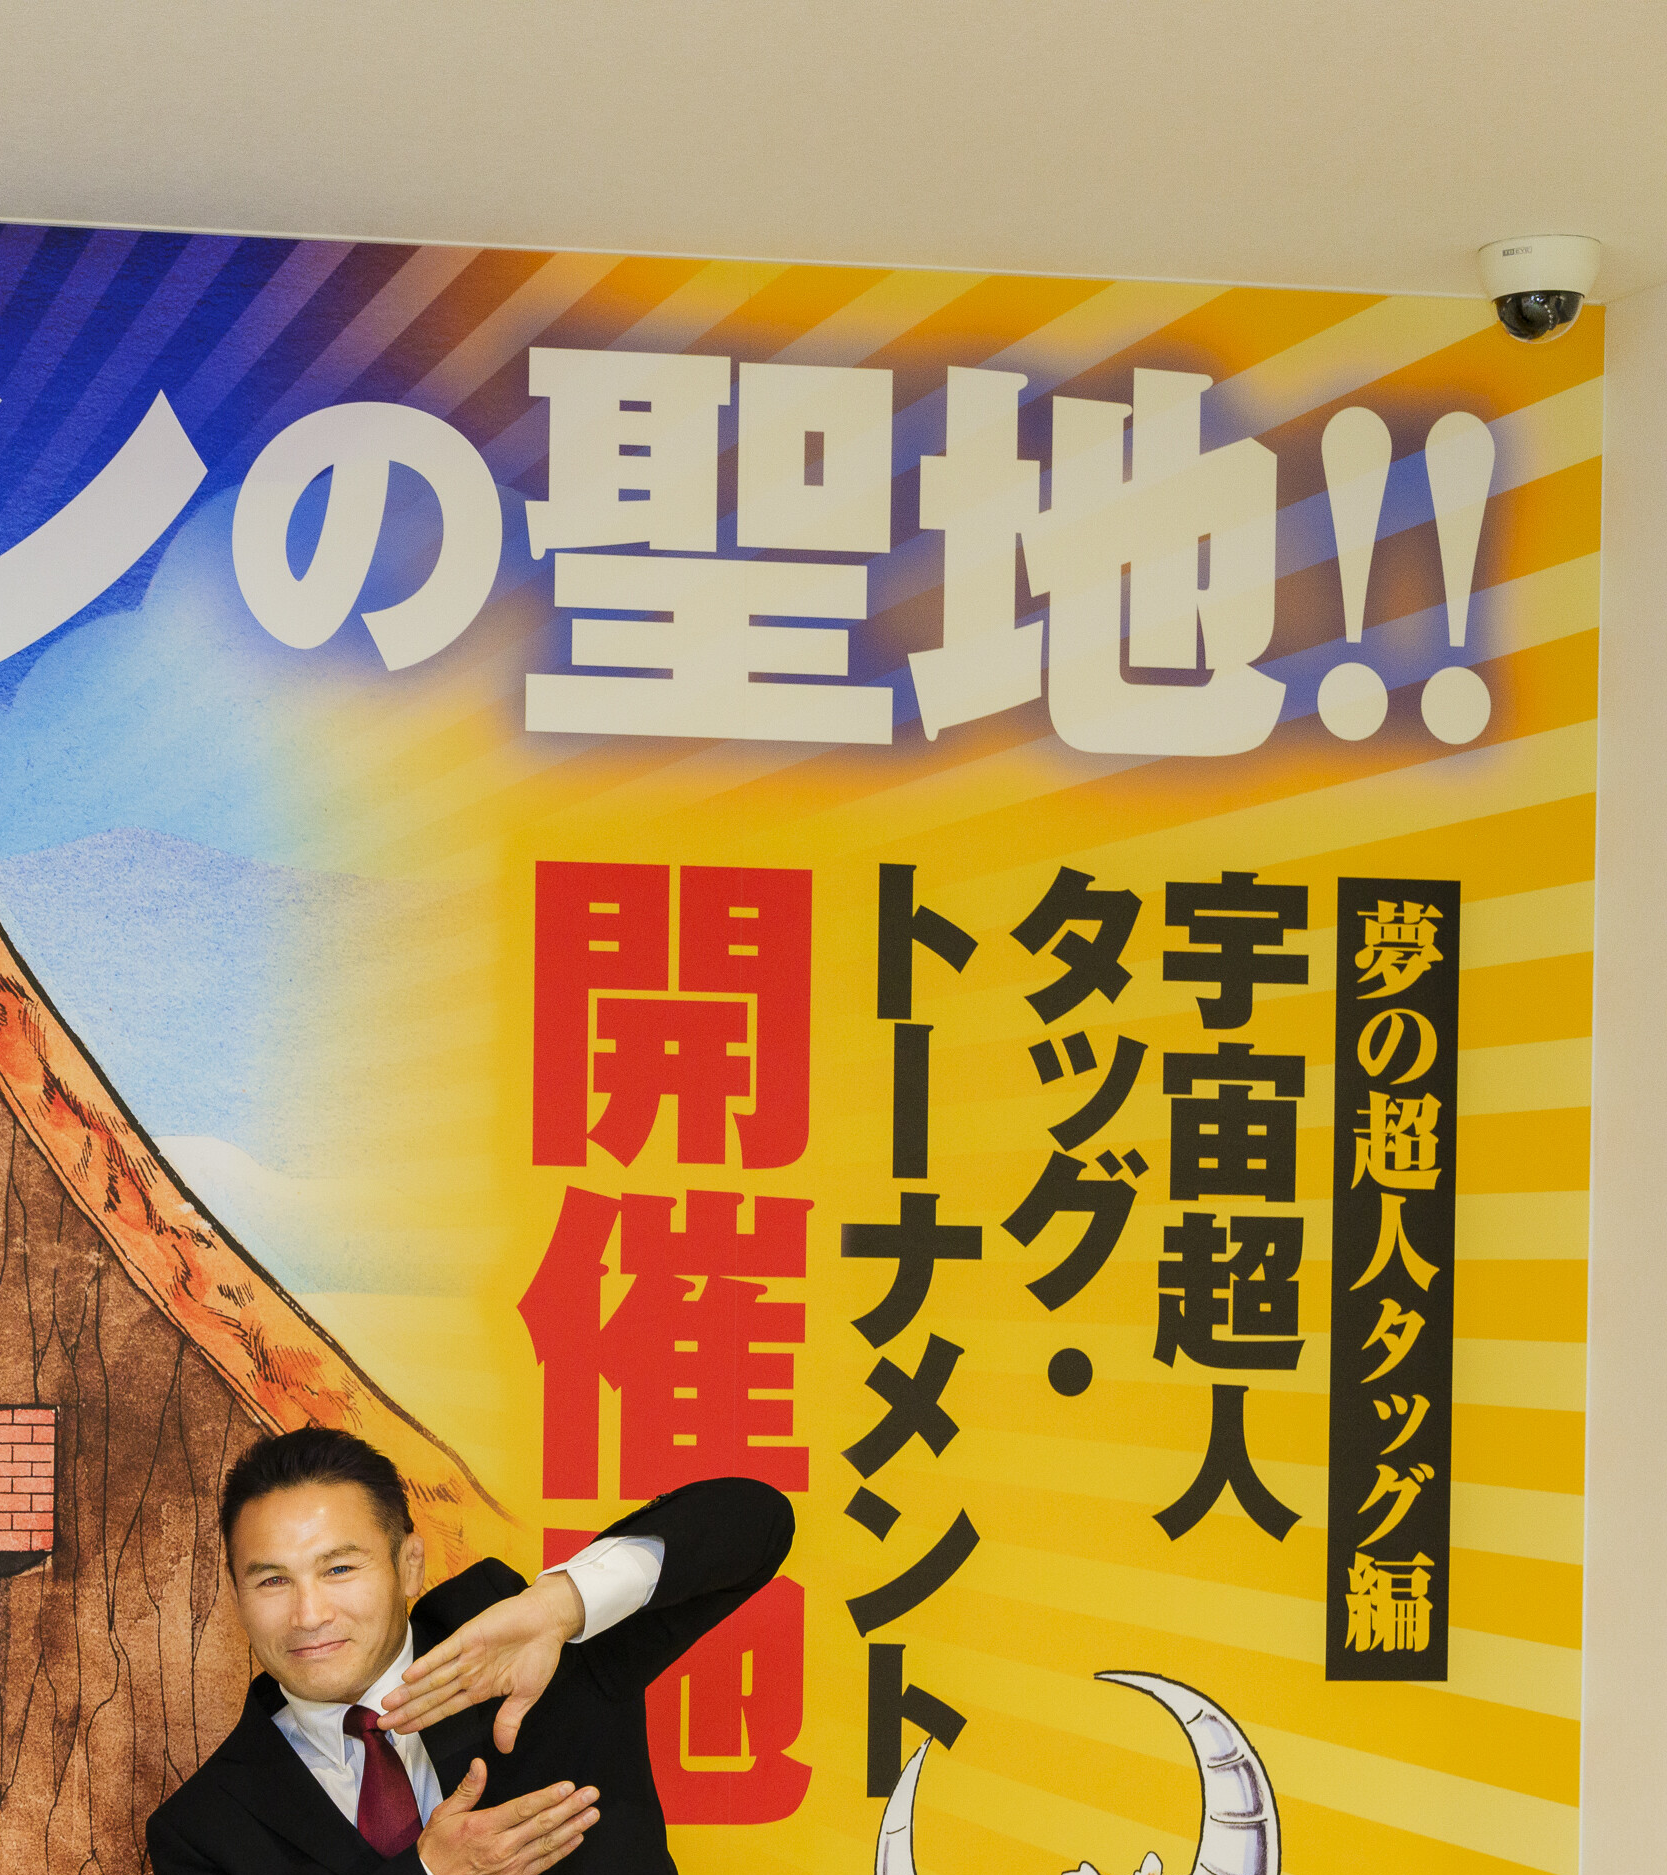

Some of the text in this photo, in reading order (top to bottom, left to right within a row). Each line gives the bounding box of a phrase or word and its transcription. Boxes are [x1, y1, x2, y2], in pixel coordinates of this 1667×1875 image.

[841, 864, 983, 1798] トーナメント
[1152, 871, 1309, 1542] 宇宙超人
[1343, 899, 1445, 1653] 夢の超人タッグ編
